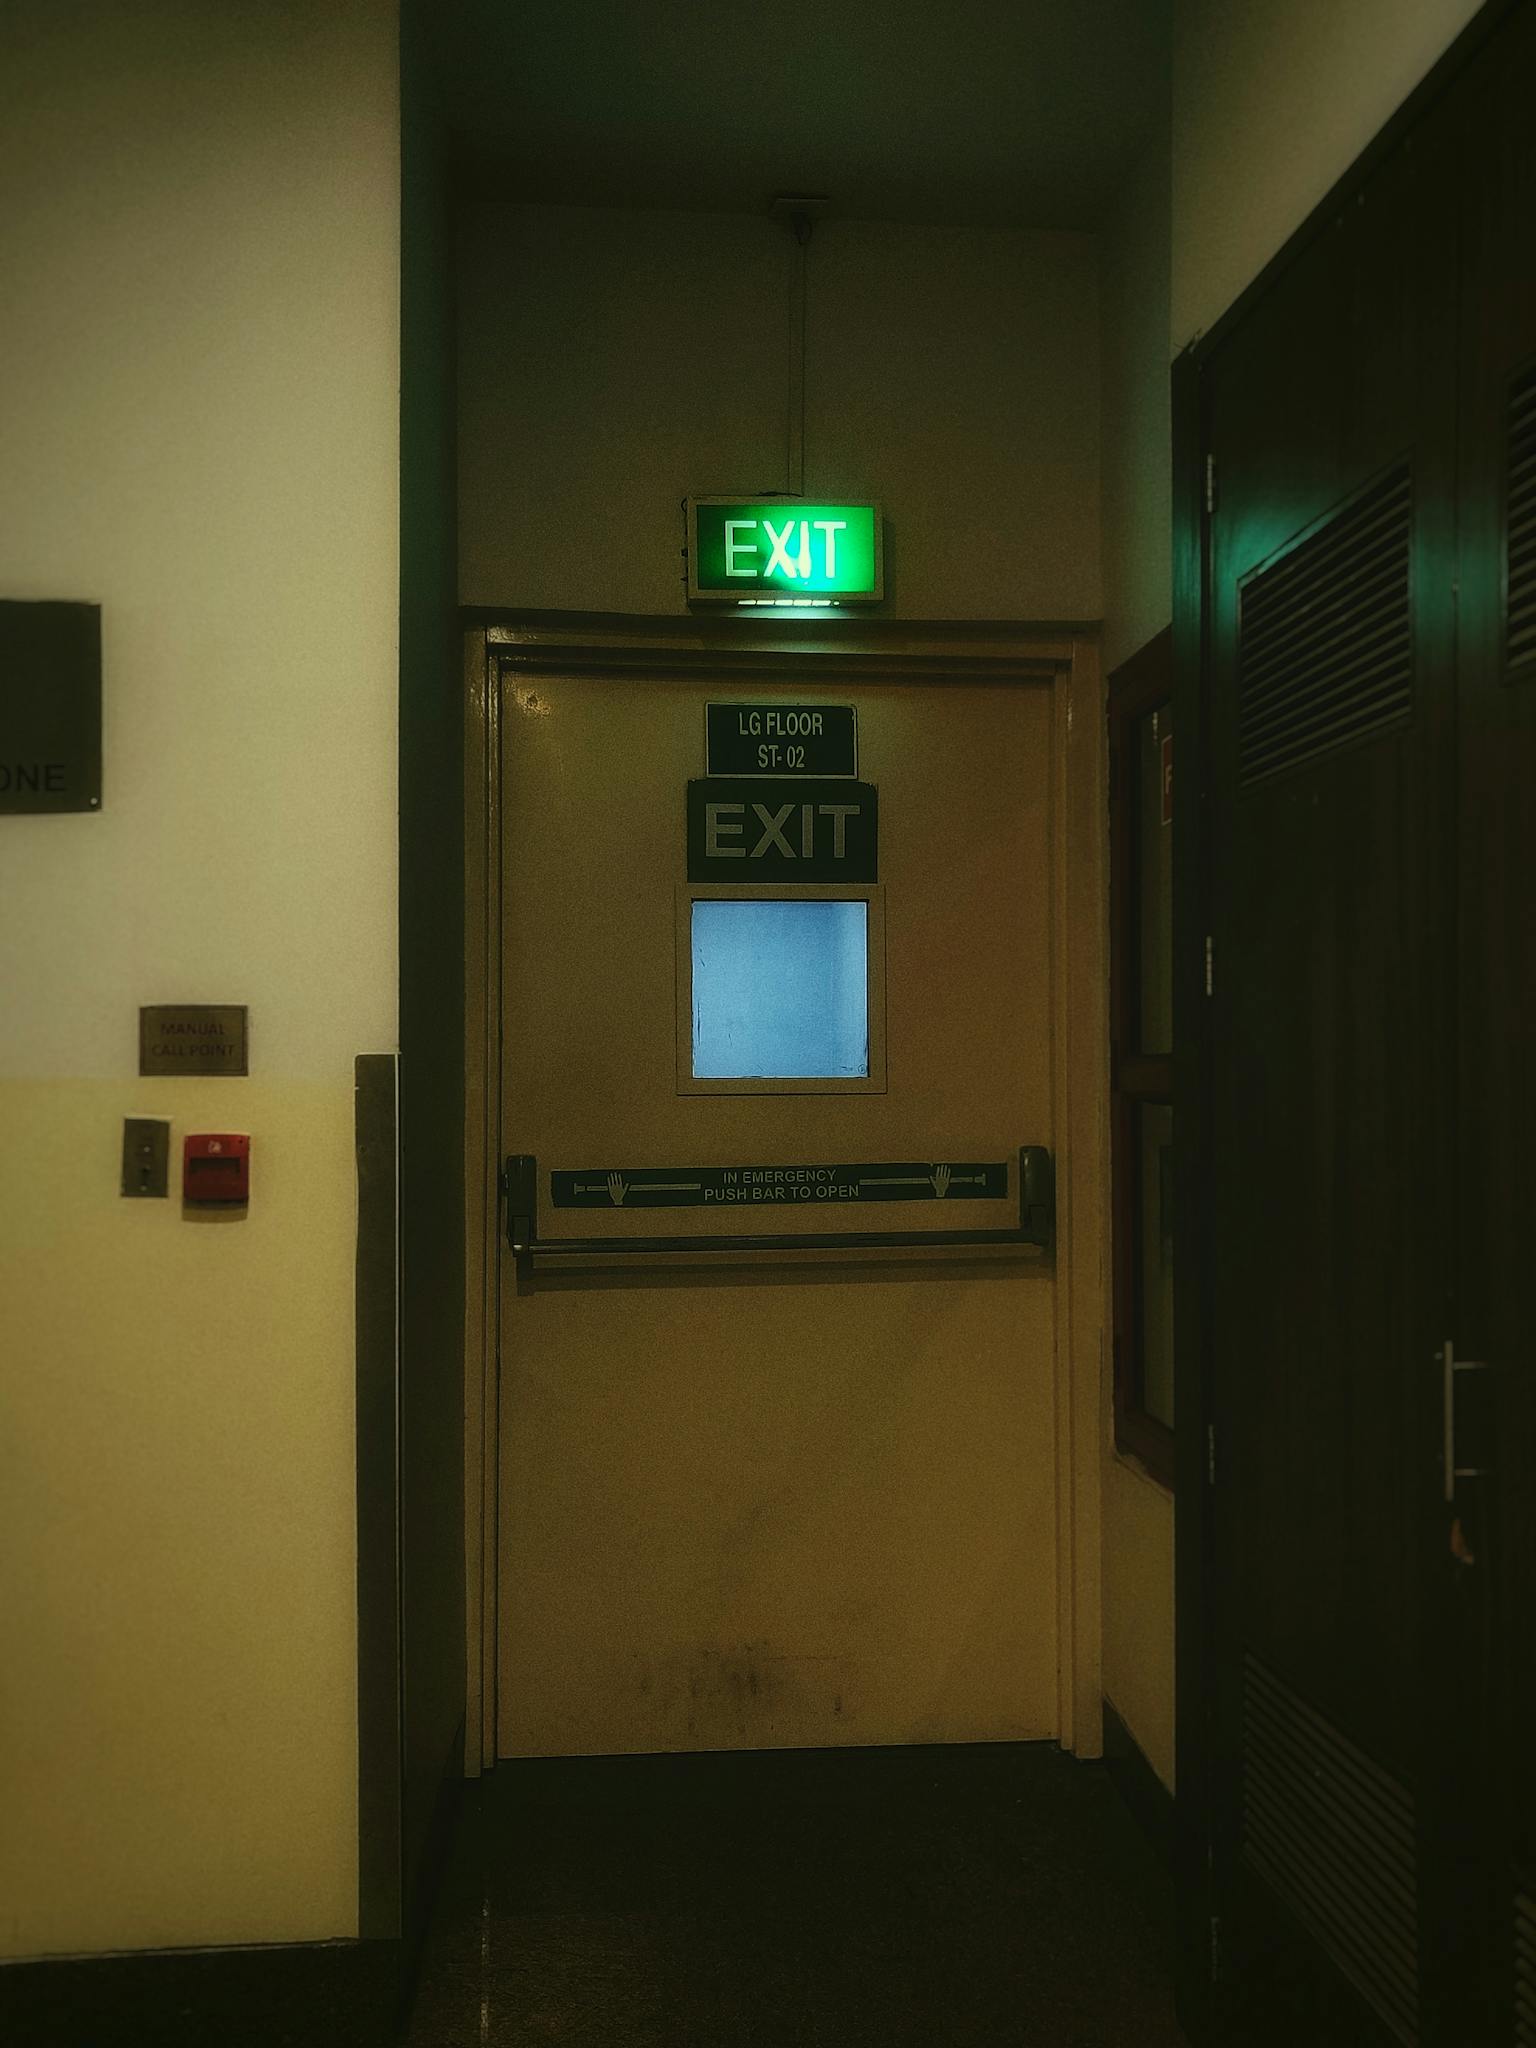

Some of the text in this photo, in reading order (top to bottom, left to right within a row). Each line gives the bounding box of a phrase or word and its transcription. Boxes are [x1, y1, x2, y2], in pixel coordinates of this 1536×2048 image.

[724, 520, 847, 578] EXIT
[738, 711, 824, 736] LG FLOOR
[786, 745, 805, 768] 02
[705, 803, 861, 859] EXIT
[160, 1023, 226, 1035] MANUAL
[723, 1169, 837, 1184] IN EMERGENCY
[704, 1184, 860, 1201] PUSH BAR TO OPEN
